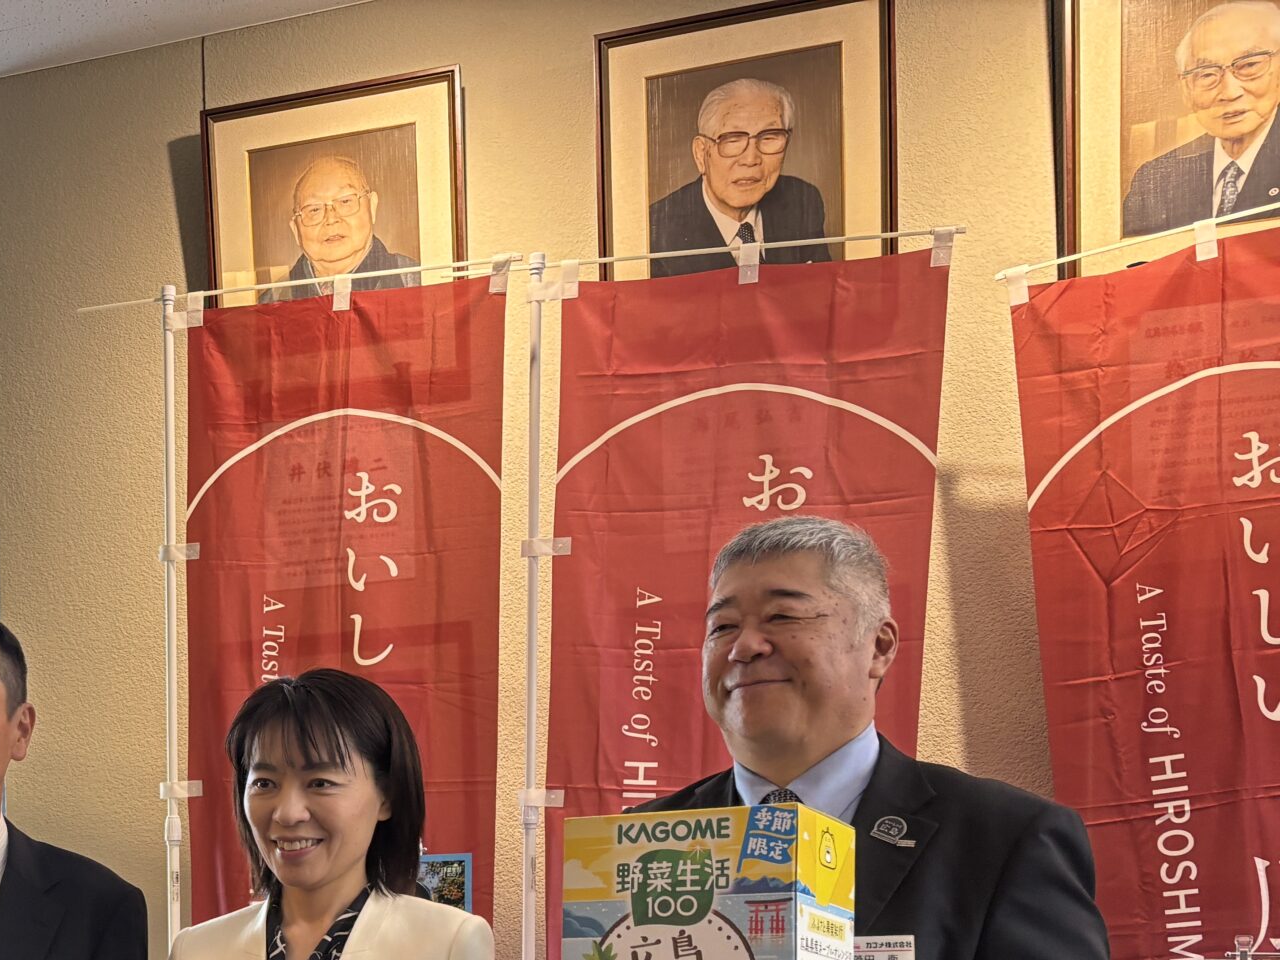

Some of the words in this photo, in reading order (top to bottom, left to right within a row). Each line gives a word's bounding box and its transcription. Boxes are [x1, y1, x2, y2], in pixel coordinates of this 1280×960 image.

[263, 595, 286, 614] A
[636, 587, 663, 608] A
[1135, 583, 1164, 603] A
[261, 625, 286, 683] Tast
[632, 621, 661, 701] Taste
[1139, 613, 1170, 694] Taste
[622, 714, 658, 747] of
[1140, 708, 1181, 738] of
[622, 761, 659, 812] HI
[617, 817, 730, 845] KAGOME
[754, 808, 795, 832] 季節
[747, 837, 788, 860] 限定
[616, 858, 730, 894] 野菜生活
[646, 894, 698, 918] 100
